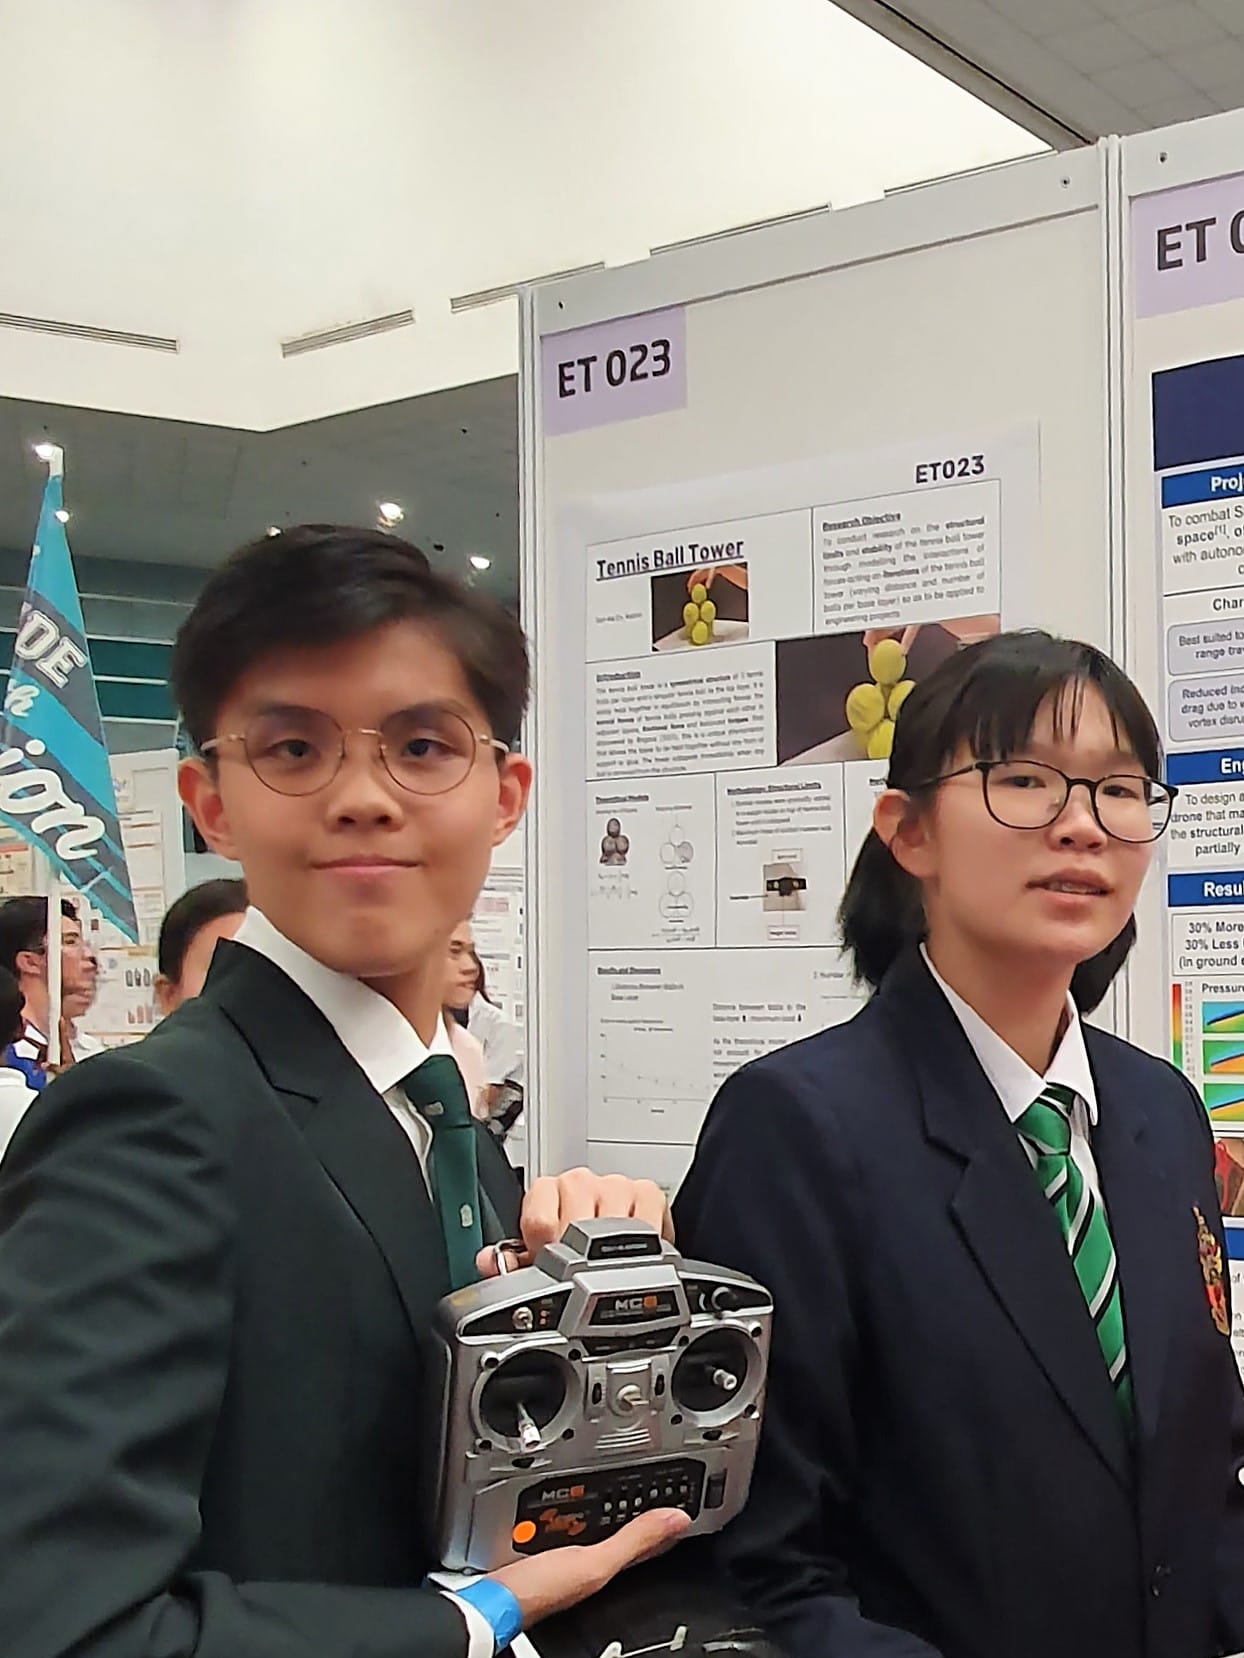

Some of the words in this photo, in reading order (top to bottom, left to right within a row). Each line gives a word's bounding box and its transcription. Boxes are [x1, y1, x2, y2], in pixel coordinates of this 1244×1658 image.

[1157, 217, 1216, 270] ET
[558, 353, 596, 398] ET
[606, 339, 671, 389] 023
[916, 455, 984, 483] ET023
[1169, 515, 1182, 528] To
[1185, 509, 1230, 525] combat
[597, 553, 649, 578] Tennis
[654, 546, 684, 568] Ball
[689, 541, 744, 563] Tower
[1173, 551, 1197, 565] with
[1185, 794, 1197, 805] To
[1200, 792, 1236, 806] design
[1239, 791, 1244, 801] a
[1171, 811, 1202, 824] drone
[1205, 809, 1226, 821] that
[1171, 827, 1187, 839] the
[1190, 824, 1244, 839] structural
[1195, 841, 1240, 857] partially
[1188, 922, 1212, 934] 30%
[1215, 921, 1244, 932] More
[1185, 938, 1208, 950] 30%
[1211, 938, 1240, 950] Less
[1179, 956, 1193, 969] (in
[1196, 955, 1238, 971] ground
